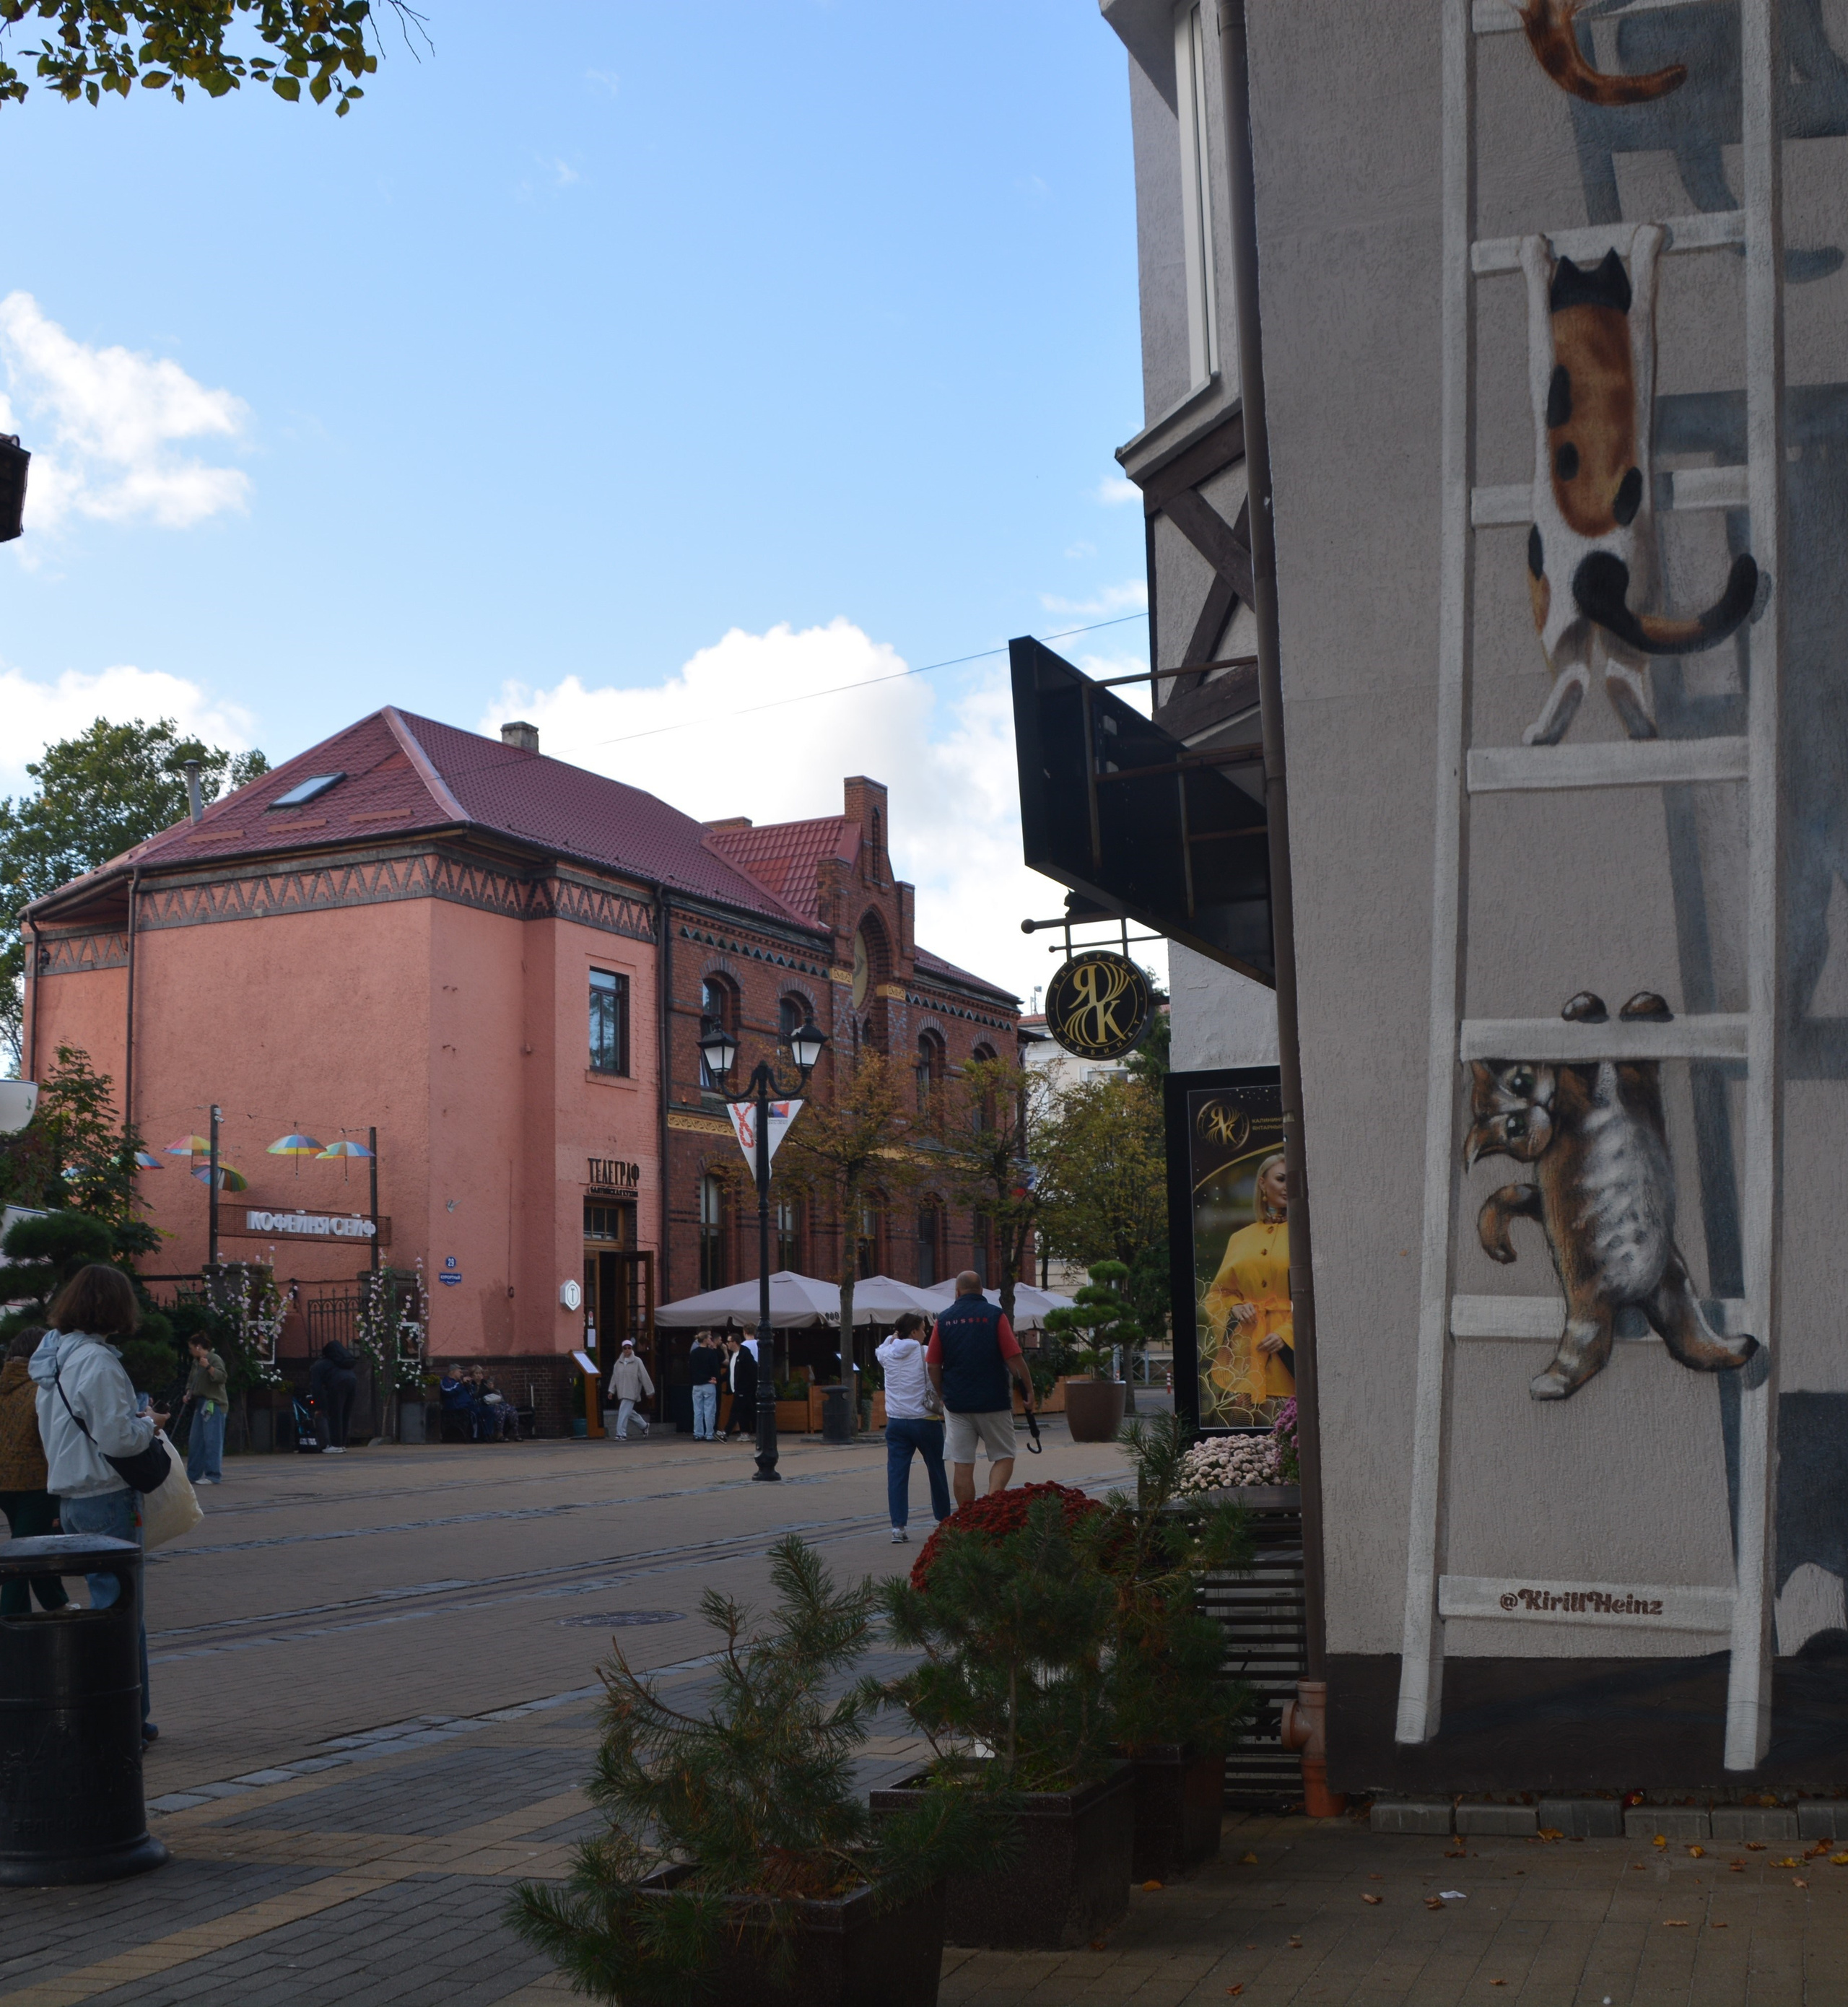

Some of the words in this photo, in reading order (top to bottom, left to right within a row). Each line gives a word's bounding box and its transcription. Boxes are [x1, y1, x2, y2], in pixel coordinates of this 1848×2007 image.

[1054, 953, 1138, 989] ЯНТАРНЫЙ
[1056, 1019, 1141, 1055] КОМБИНАТ
[588, 1157, 640, 1188] ТЕЛЕГРАФ
[247, 1209, 329, 1235] КОФЕЙНЯ
[330, 1213, 376, 1237] СЕЙФ
[946, 1317, 988, 1326] RUSSIA
[1499, 1588, 1664, 1616] @KirillHeinz
